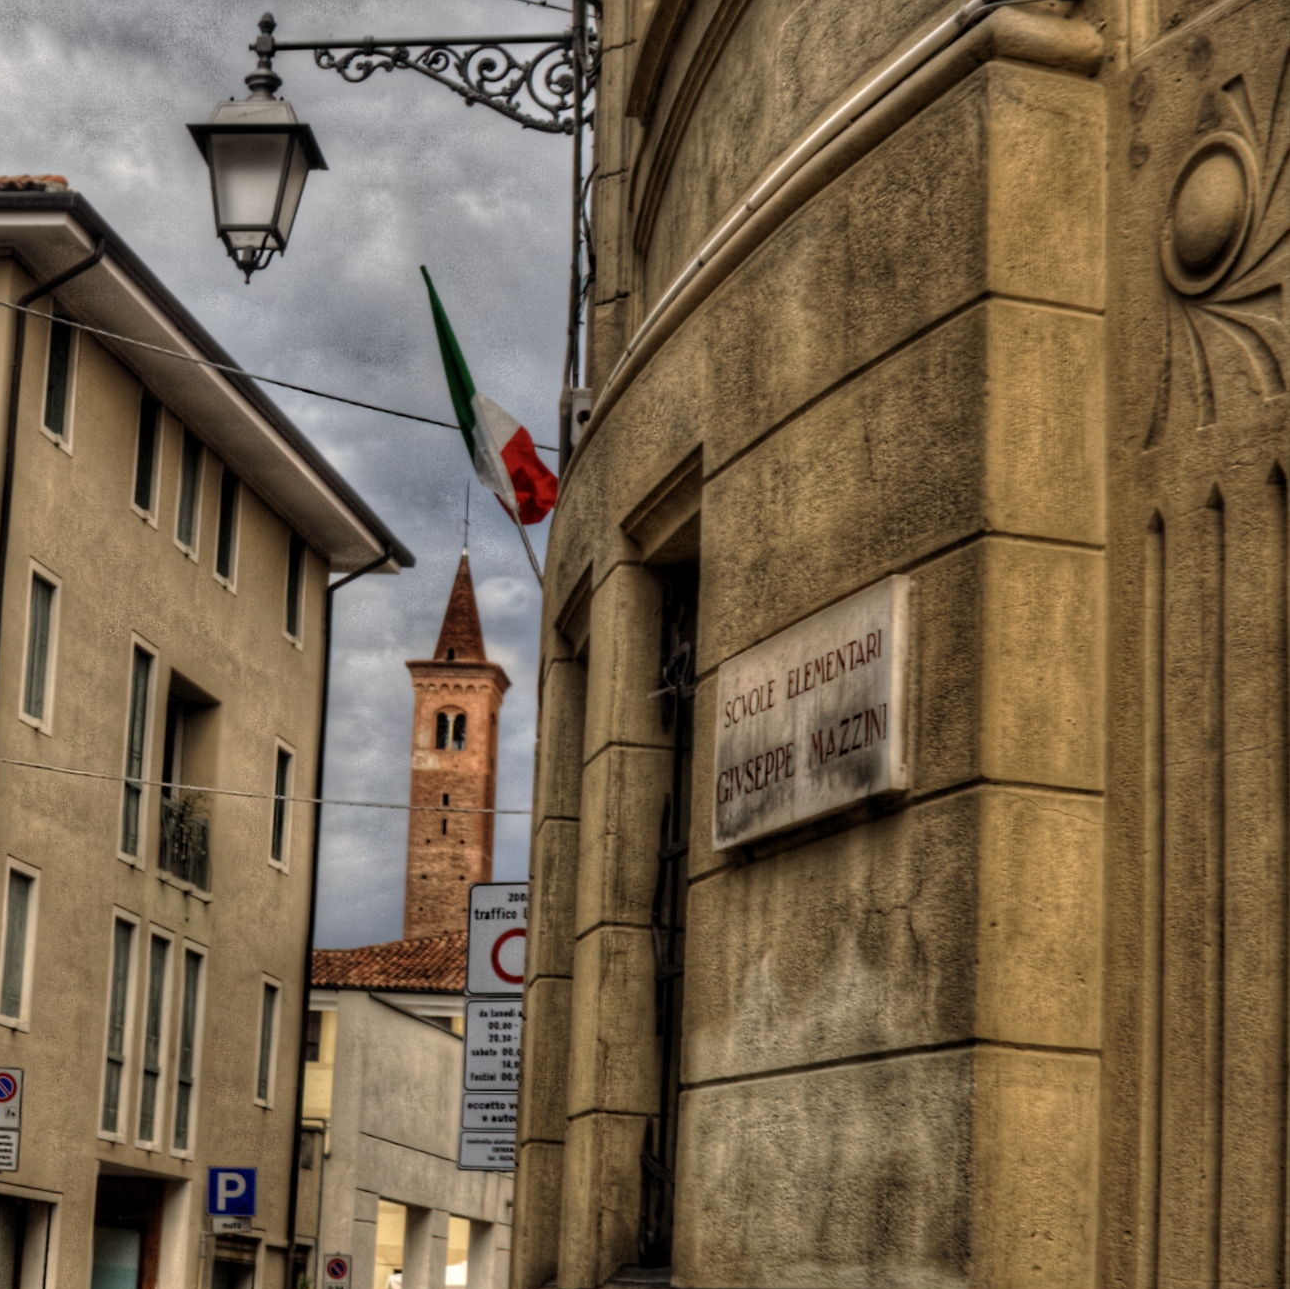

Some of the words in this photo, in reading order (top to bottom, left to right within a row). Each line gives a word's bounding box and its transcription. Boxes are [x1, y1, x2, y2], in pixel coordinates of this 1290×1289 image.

[724, 679, 775, 729] SCVOLE
[787, 629, 882, 700] ELEMENTARI
[716, 741, 795, 806] GIVSEPPE
[809, 702, 888, 769] MAZZINI
[508, 892, 529, 903] zon
[474, 906, 517, 920] traffico
[467, 1100, 506, 1110] eccetto
[217, 1172, 247, 1211] P
